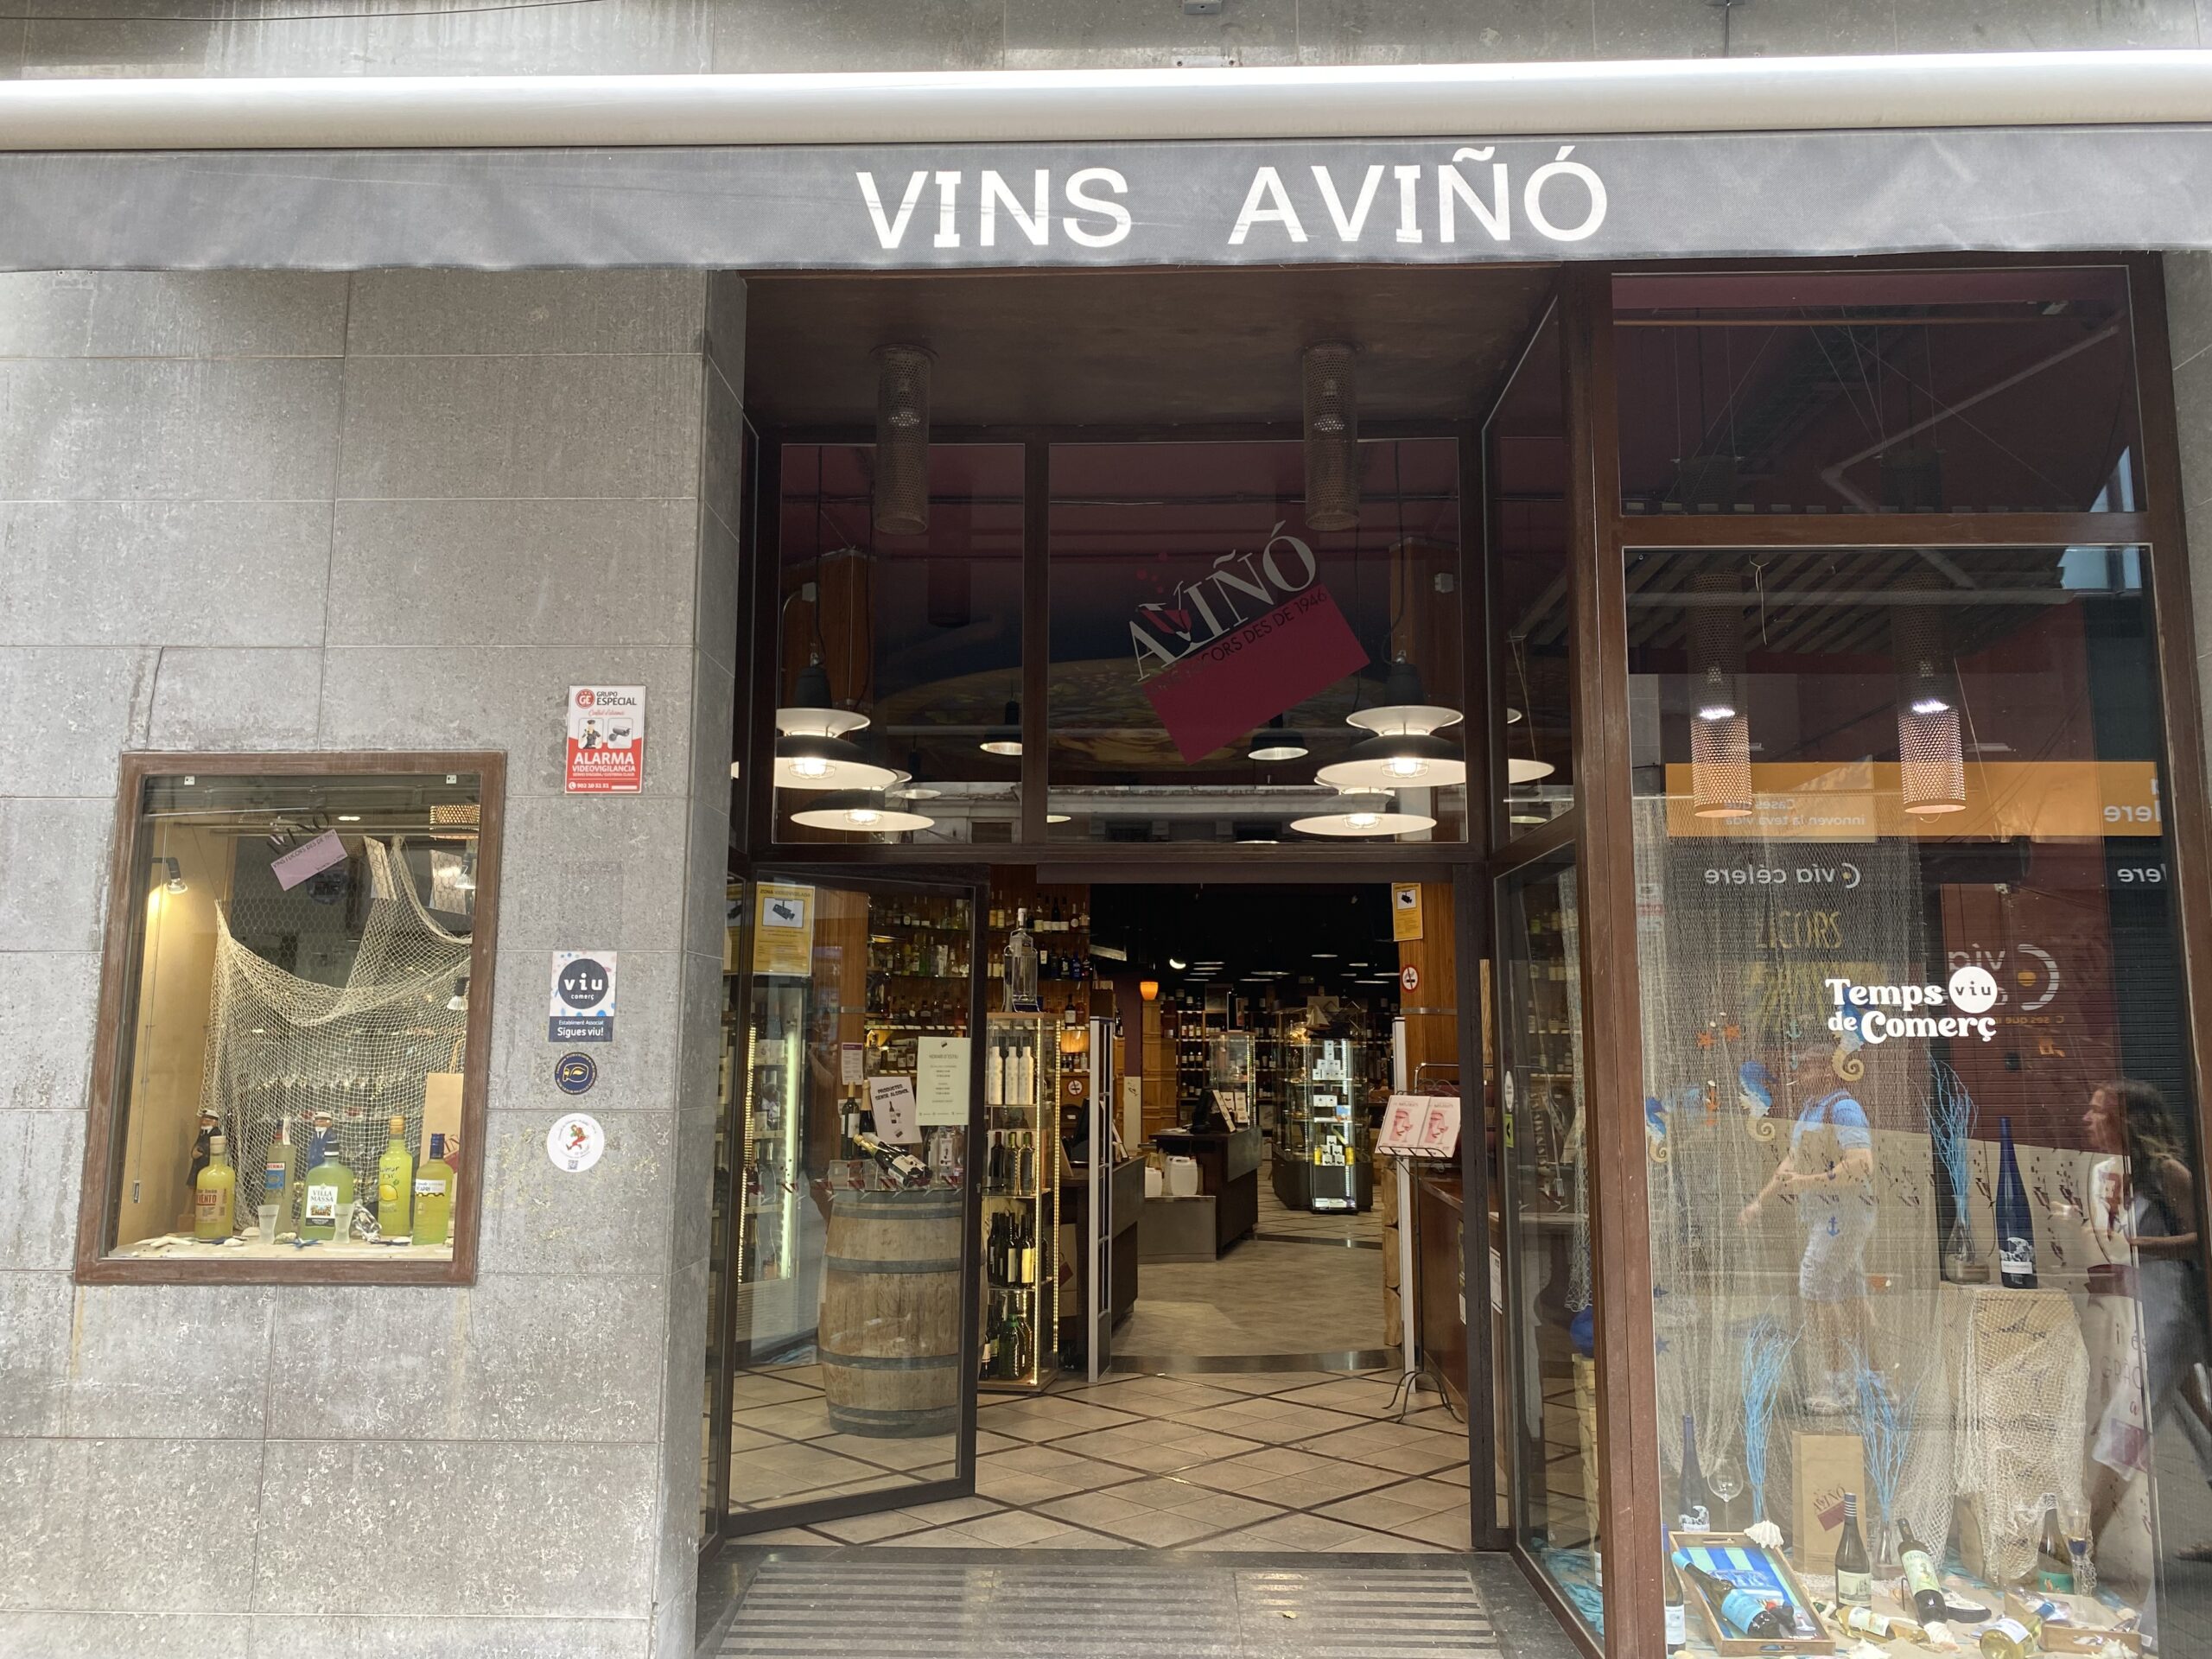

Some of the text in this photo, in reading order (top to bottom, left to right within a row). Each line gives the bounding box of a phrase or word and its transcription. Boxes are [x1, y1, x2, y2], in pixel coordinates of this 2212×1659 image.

[855, 145, 1608, 249] VINS AVIÑÓ
[1128, 520, 1316, 682] AVIÑÓ
[1243, 620, 1273, 645] DES
[1273, 611, 1294, 627] DE
[1294, 588, 1328, 613] 1946
[578, 696, 591, 705] GE
[596, 697, 637, 706] ESPECIAL
[574, 752, 634, 765] ALARMA
[563, 972, 603, 991] viu
[1825, 978, 1944, 1012] Temps
[1955, 980, 1991, 996] viu
[557, 1027, 604, 1039] Sigues viu!
[1827, 1010, 1997, 1045] de Comerç
